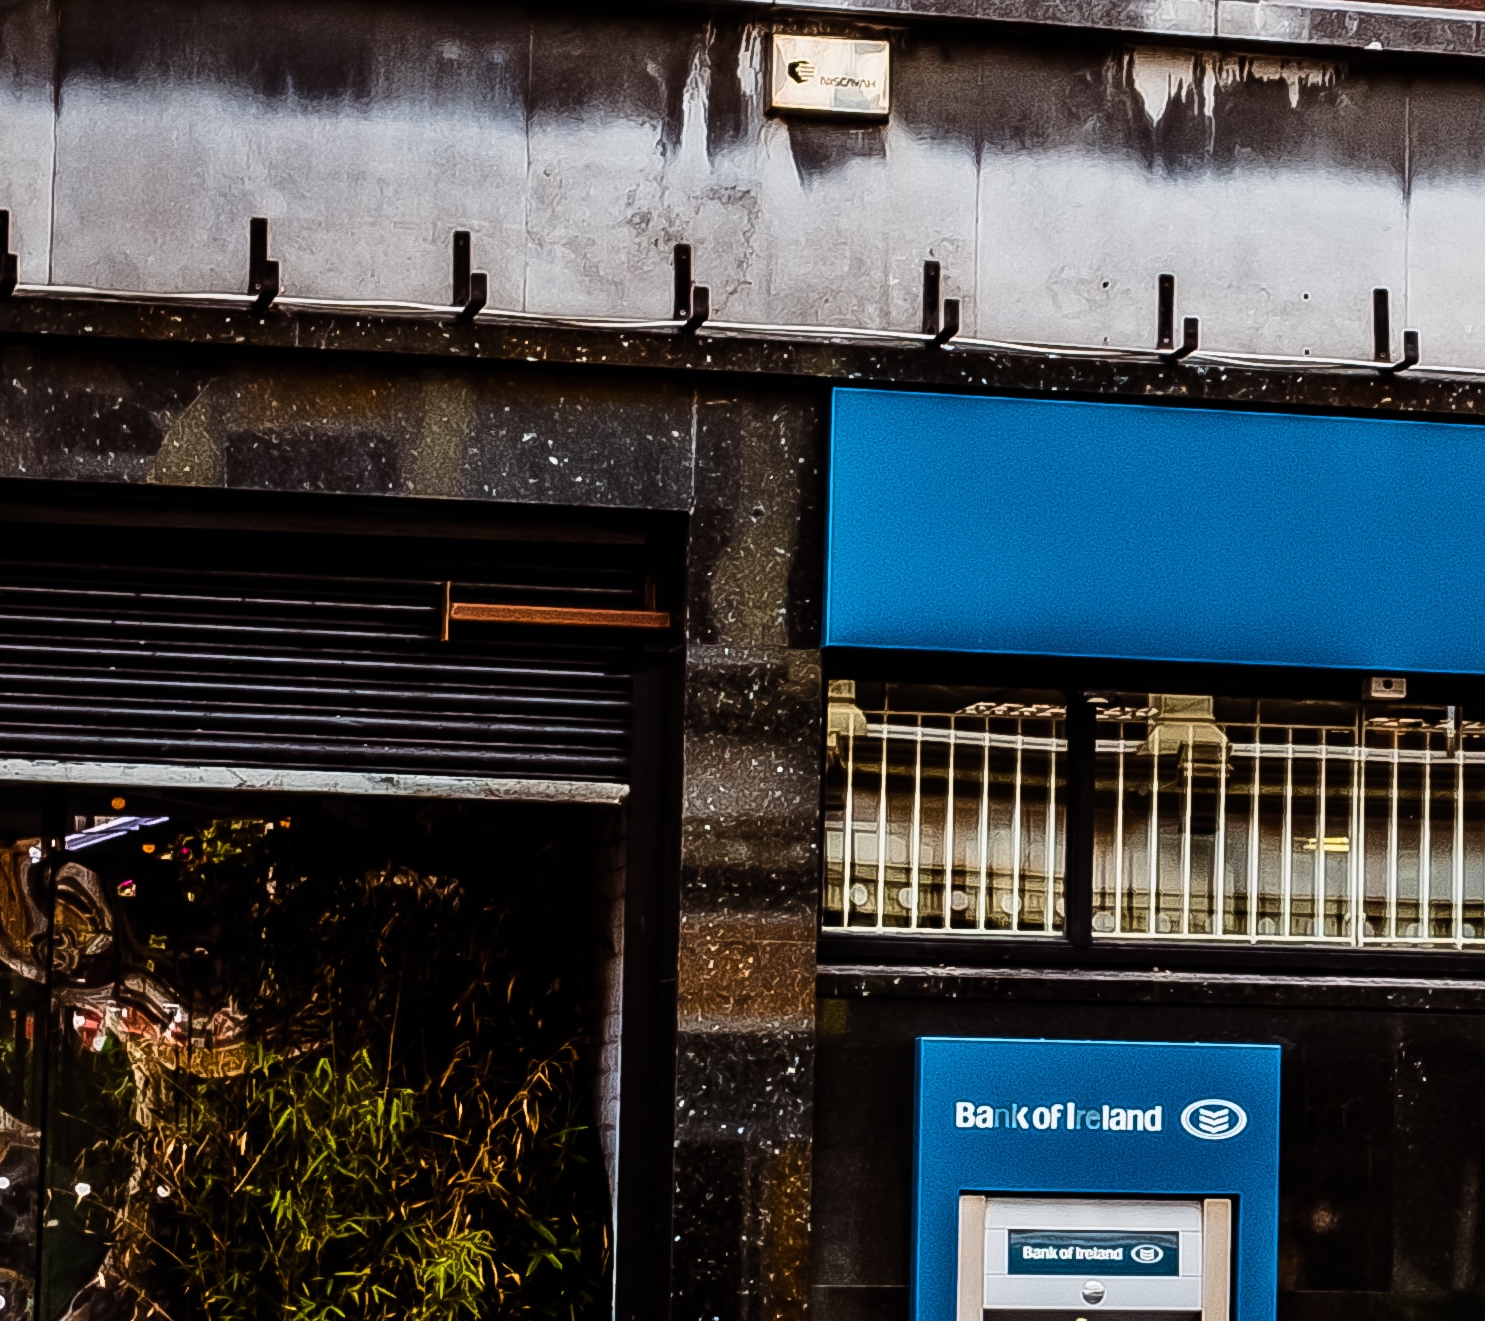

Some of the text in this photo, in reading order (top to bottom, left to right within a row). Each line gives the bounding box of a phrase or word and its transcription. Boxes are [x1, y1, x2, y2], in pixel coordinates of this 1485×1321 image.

[955, 1101, 1163, 1132] Bank of Ireland
[1022, 1245, 1124, 1261] Bank of Ireland
